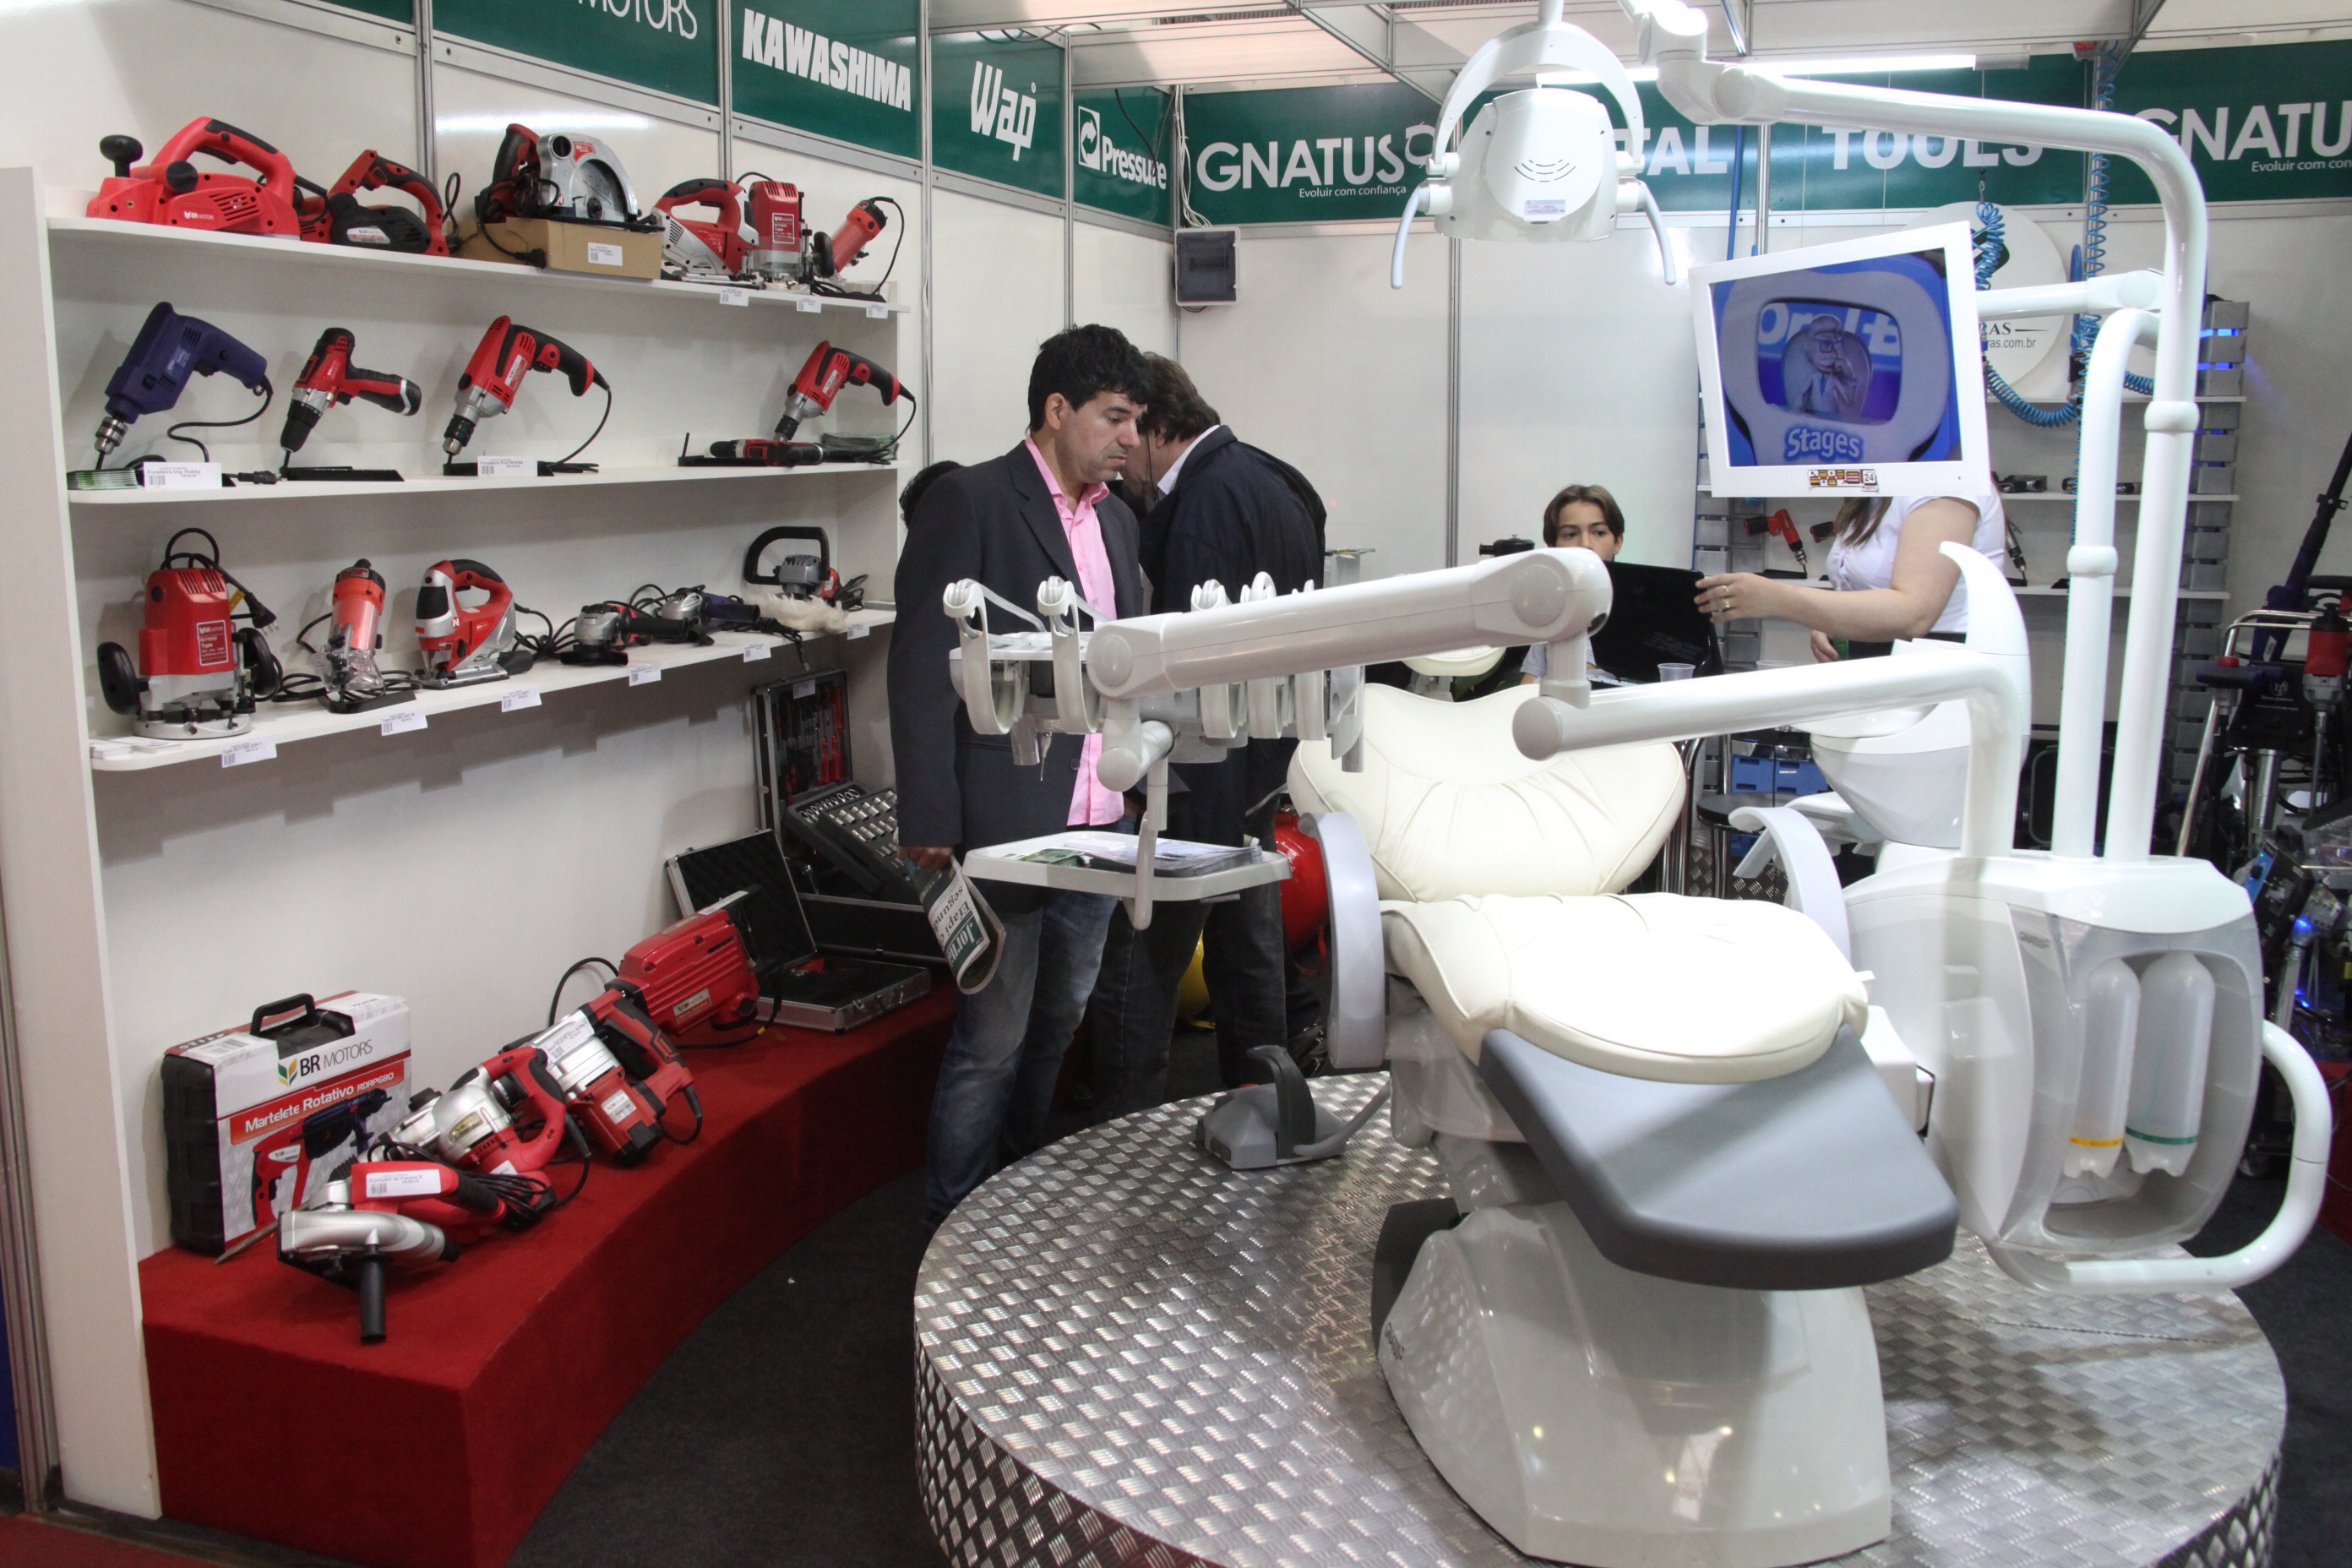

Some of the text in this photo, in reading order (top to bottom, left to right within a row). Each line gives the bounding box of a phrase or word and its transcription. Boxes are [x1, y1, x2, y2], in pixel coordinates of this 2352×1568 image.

[578, 0, 697, 40] ORS
[742, 8, 912, 112] KAWASHIMA
[1102, 135, 1167, 189] Pressure
[1196, 133, 1405, 193] GNATUS
[2251, 161, 2295, 172] Evoluir
[2297, 161, 2325, 171] com
[1299, 184, 1407, 199] Evoluir com confiança
[1788, 428, 1859, 458] Stages
[1864, 473, 1874, 482] 24
[300, 1039, 373, 1077] BR MOTORS
[245, 1072, 394, 1133] Martelete Rotativo RDRP680
